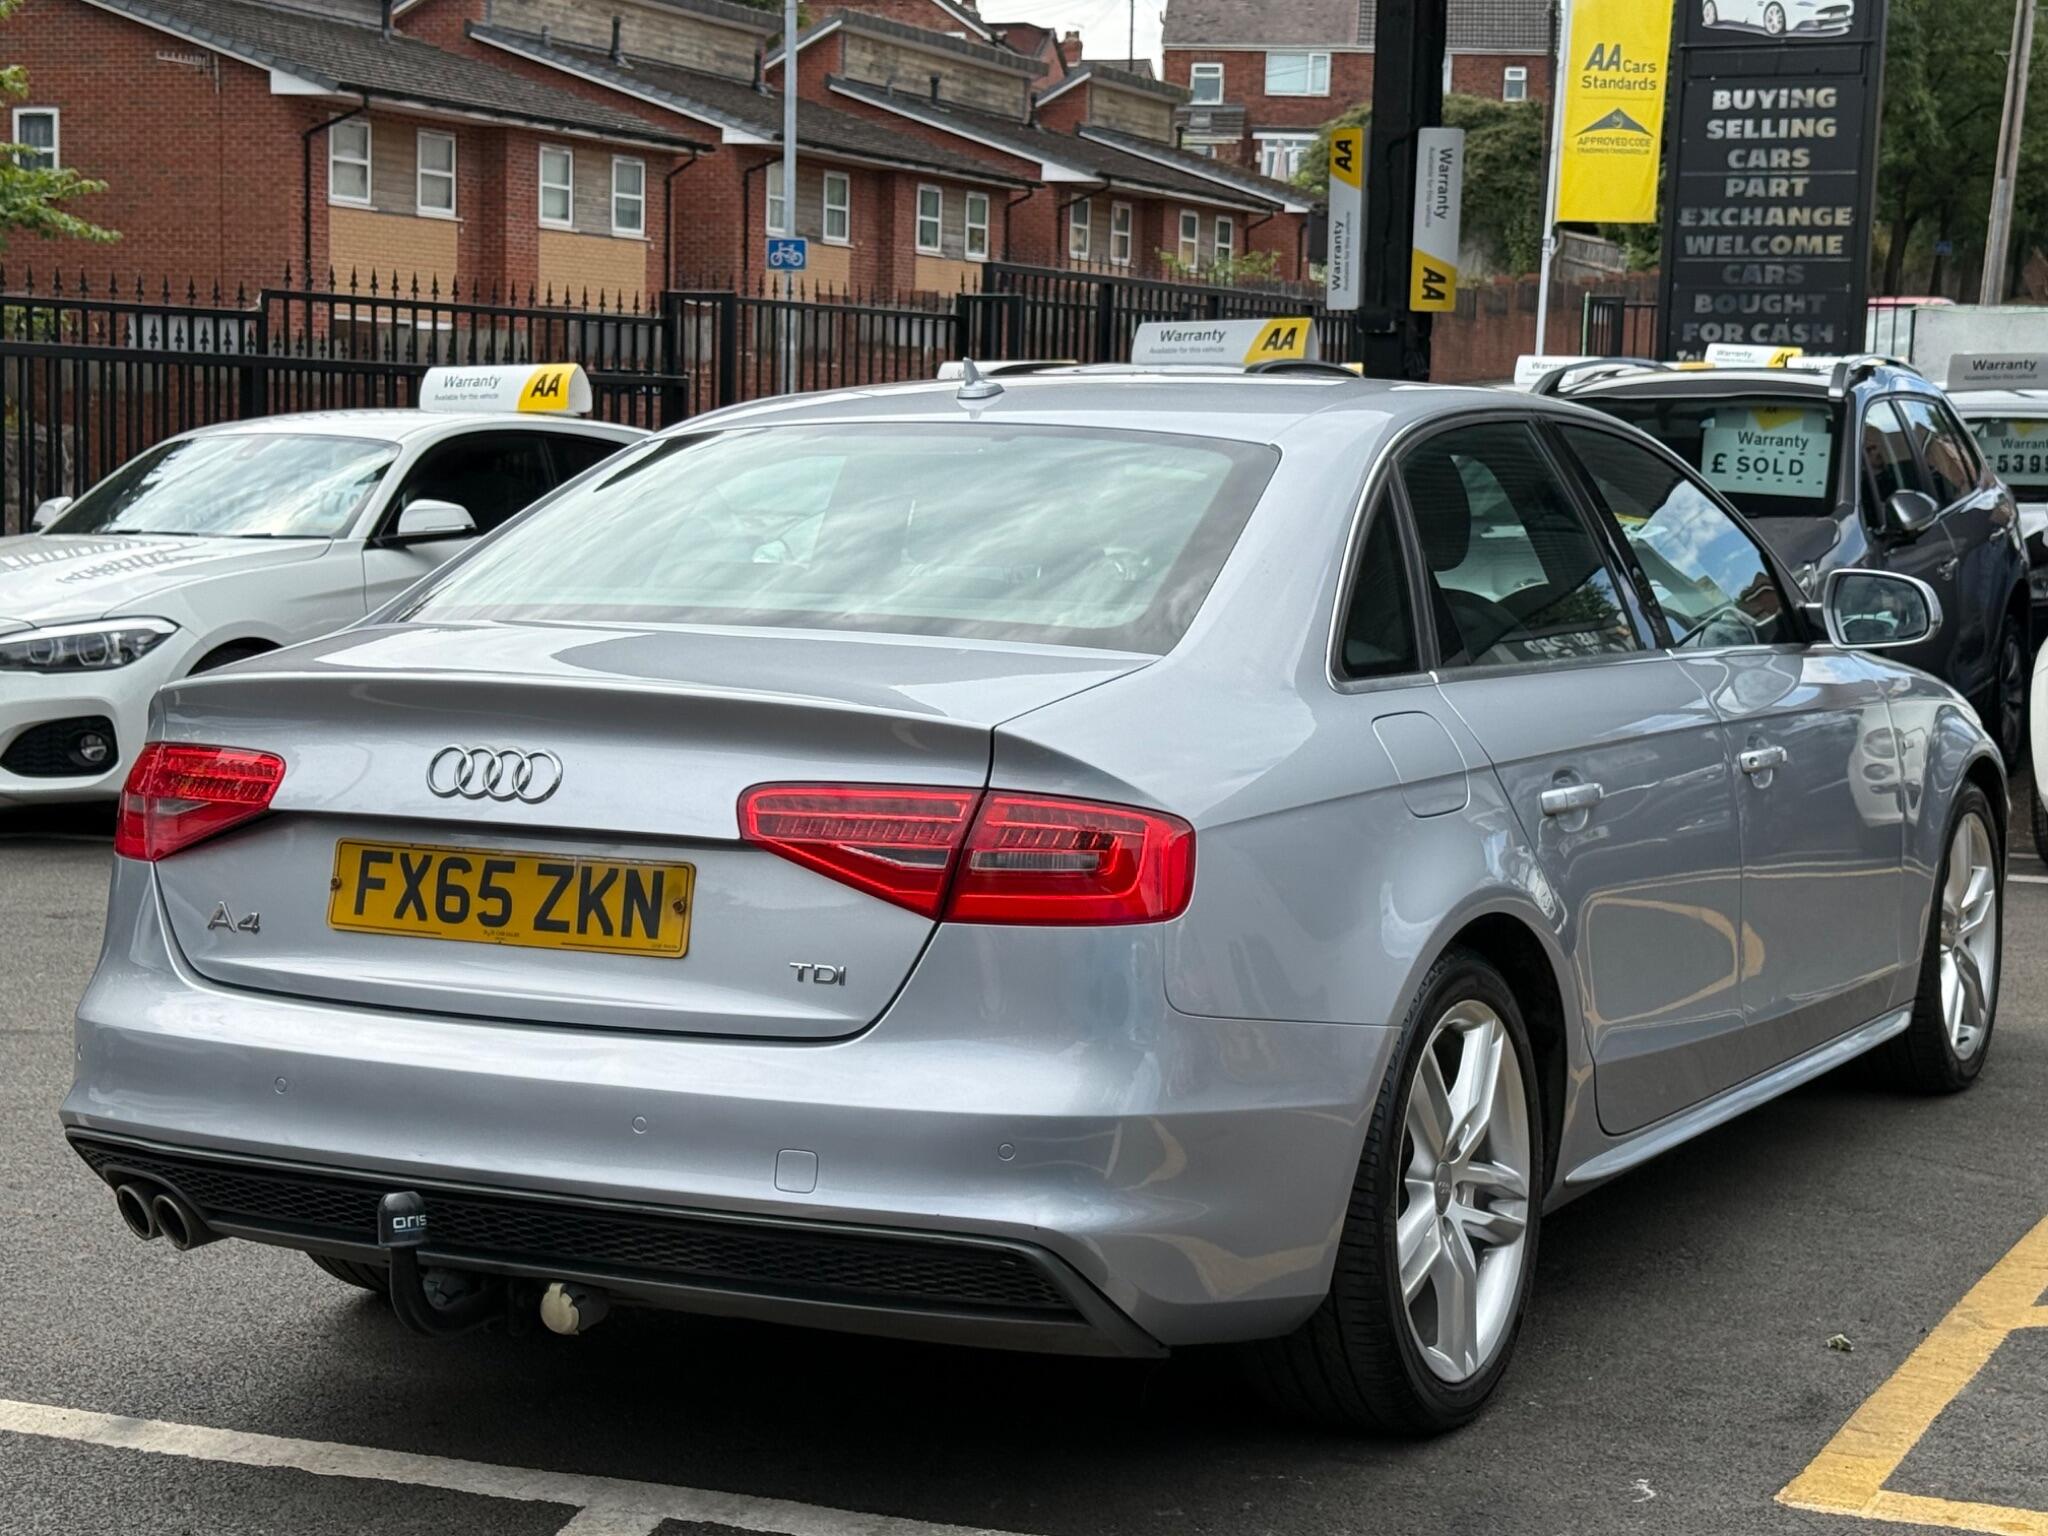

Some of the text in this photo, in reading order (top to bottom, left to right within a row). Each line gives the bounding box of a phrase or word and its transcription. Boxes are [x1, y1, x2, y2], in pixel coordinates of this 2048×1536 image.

[1583, 43, 1657, 73] AA Cars
[1580, 75, 1657, 91] Standards
[1711, 88, 1837, 111] BUYING
[1706, 118, 1837, 140] SELLING
[1577, 136, 1651, 147] APPROVED CODE
[1335, 140, 1352, 172] AA
[1727, 148, 1811, 168] CARS
[1432, 148, 1453, 220] Warranty
[1725, 177, 1810, 197] PART
[1680, 206, 1853, 227] EXCHANGE
[1332, 221, 1344, 290] Warranty
[1684, 235, 1844, 255] WELCOME
[1422, 266, 1446, 300] AA
[1722, 264, 1804, 284] CARS
[1694, 294, 1827, 314] BOUGHT
[1160, 328, 1298, 351] Warranty AA
[1682, 323, 1834, 343] FOR CASH
[1972, 359, 2037, 373] Warranty
[444, 373, 562, 397] Warranty AA
[1738, 431, 1809, 450] Warranty
[1711, 453, 1804, 476] £ SOLD
[354, 849, 665, 940] FX65 ZKN
[207, 900, 260, 934] A4
[789, 962, 846, 986] TDI
[392, 1214, 427, 1229] oris
